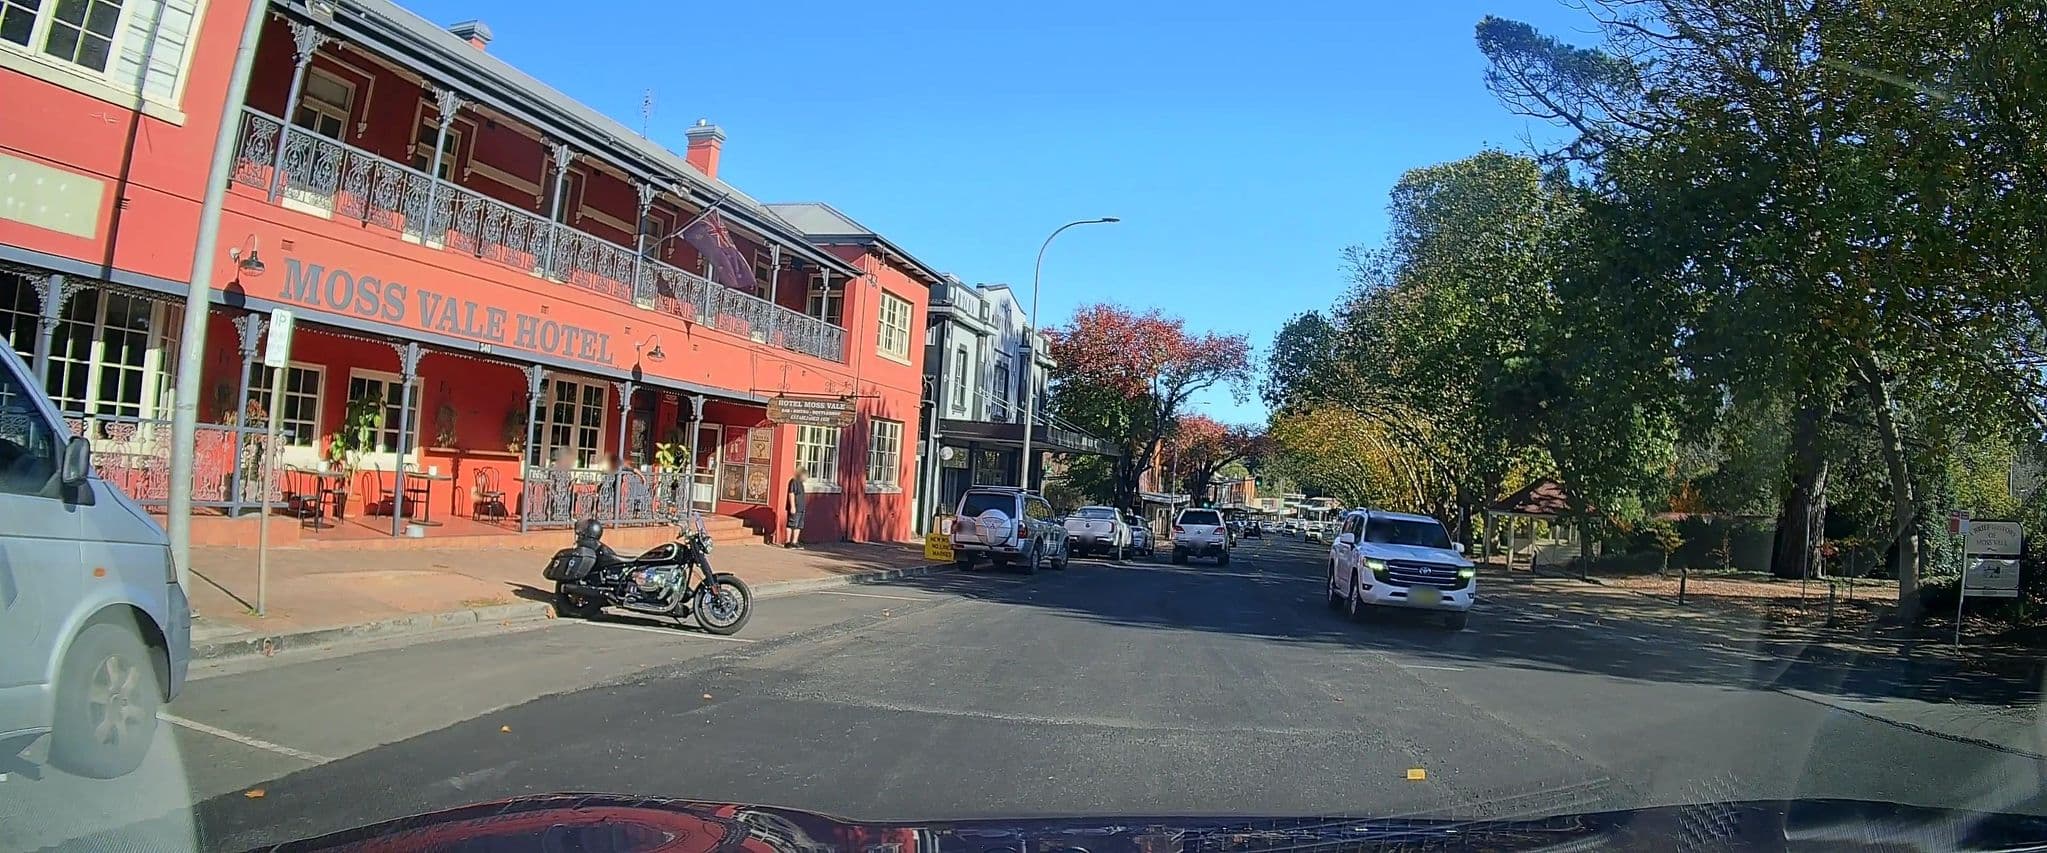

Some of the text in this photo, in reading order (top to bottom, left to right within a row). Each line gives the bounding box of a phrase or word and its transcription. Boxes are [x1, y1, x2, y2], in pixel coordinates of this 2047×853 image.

[279, 257, 614, 364] MOSS VALE HOTEL
[804, 401, 826, 409] MOSS
[827, 402, 846, 410] VALE
